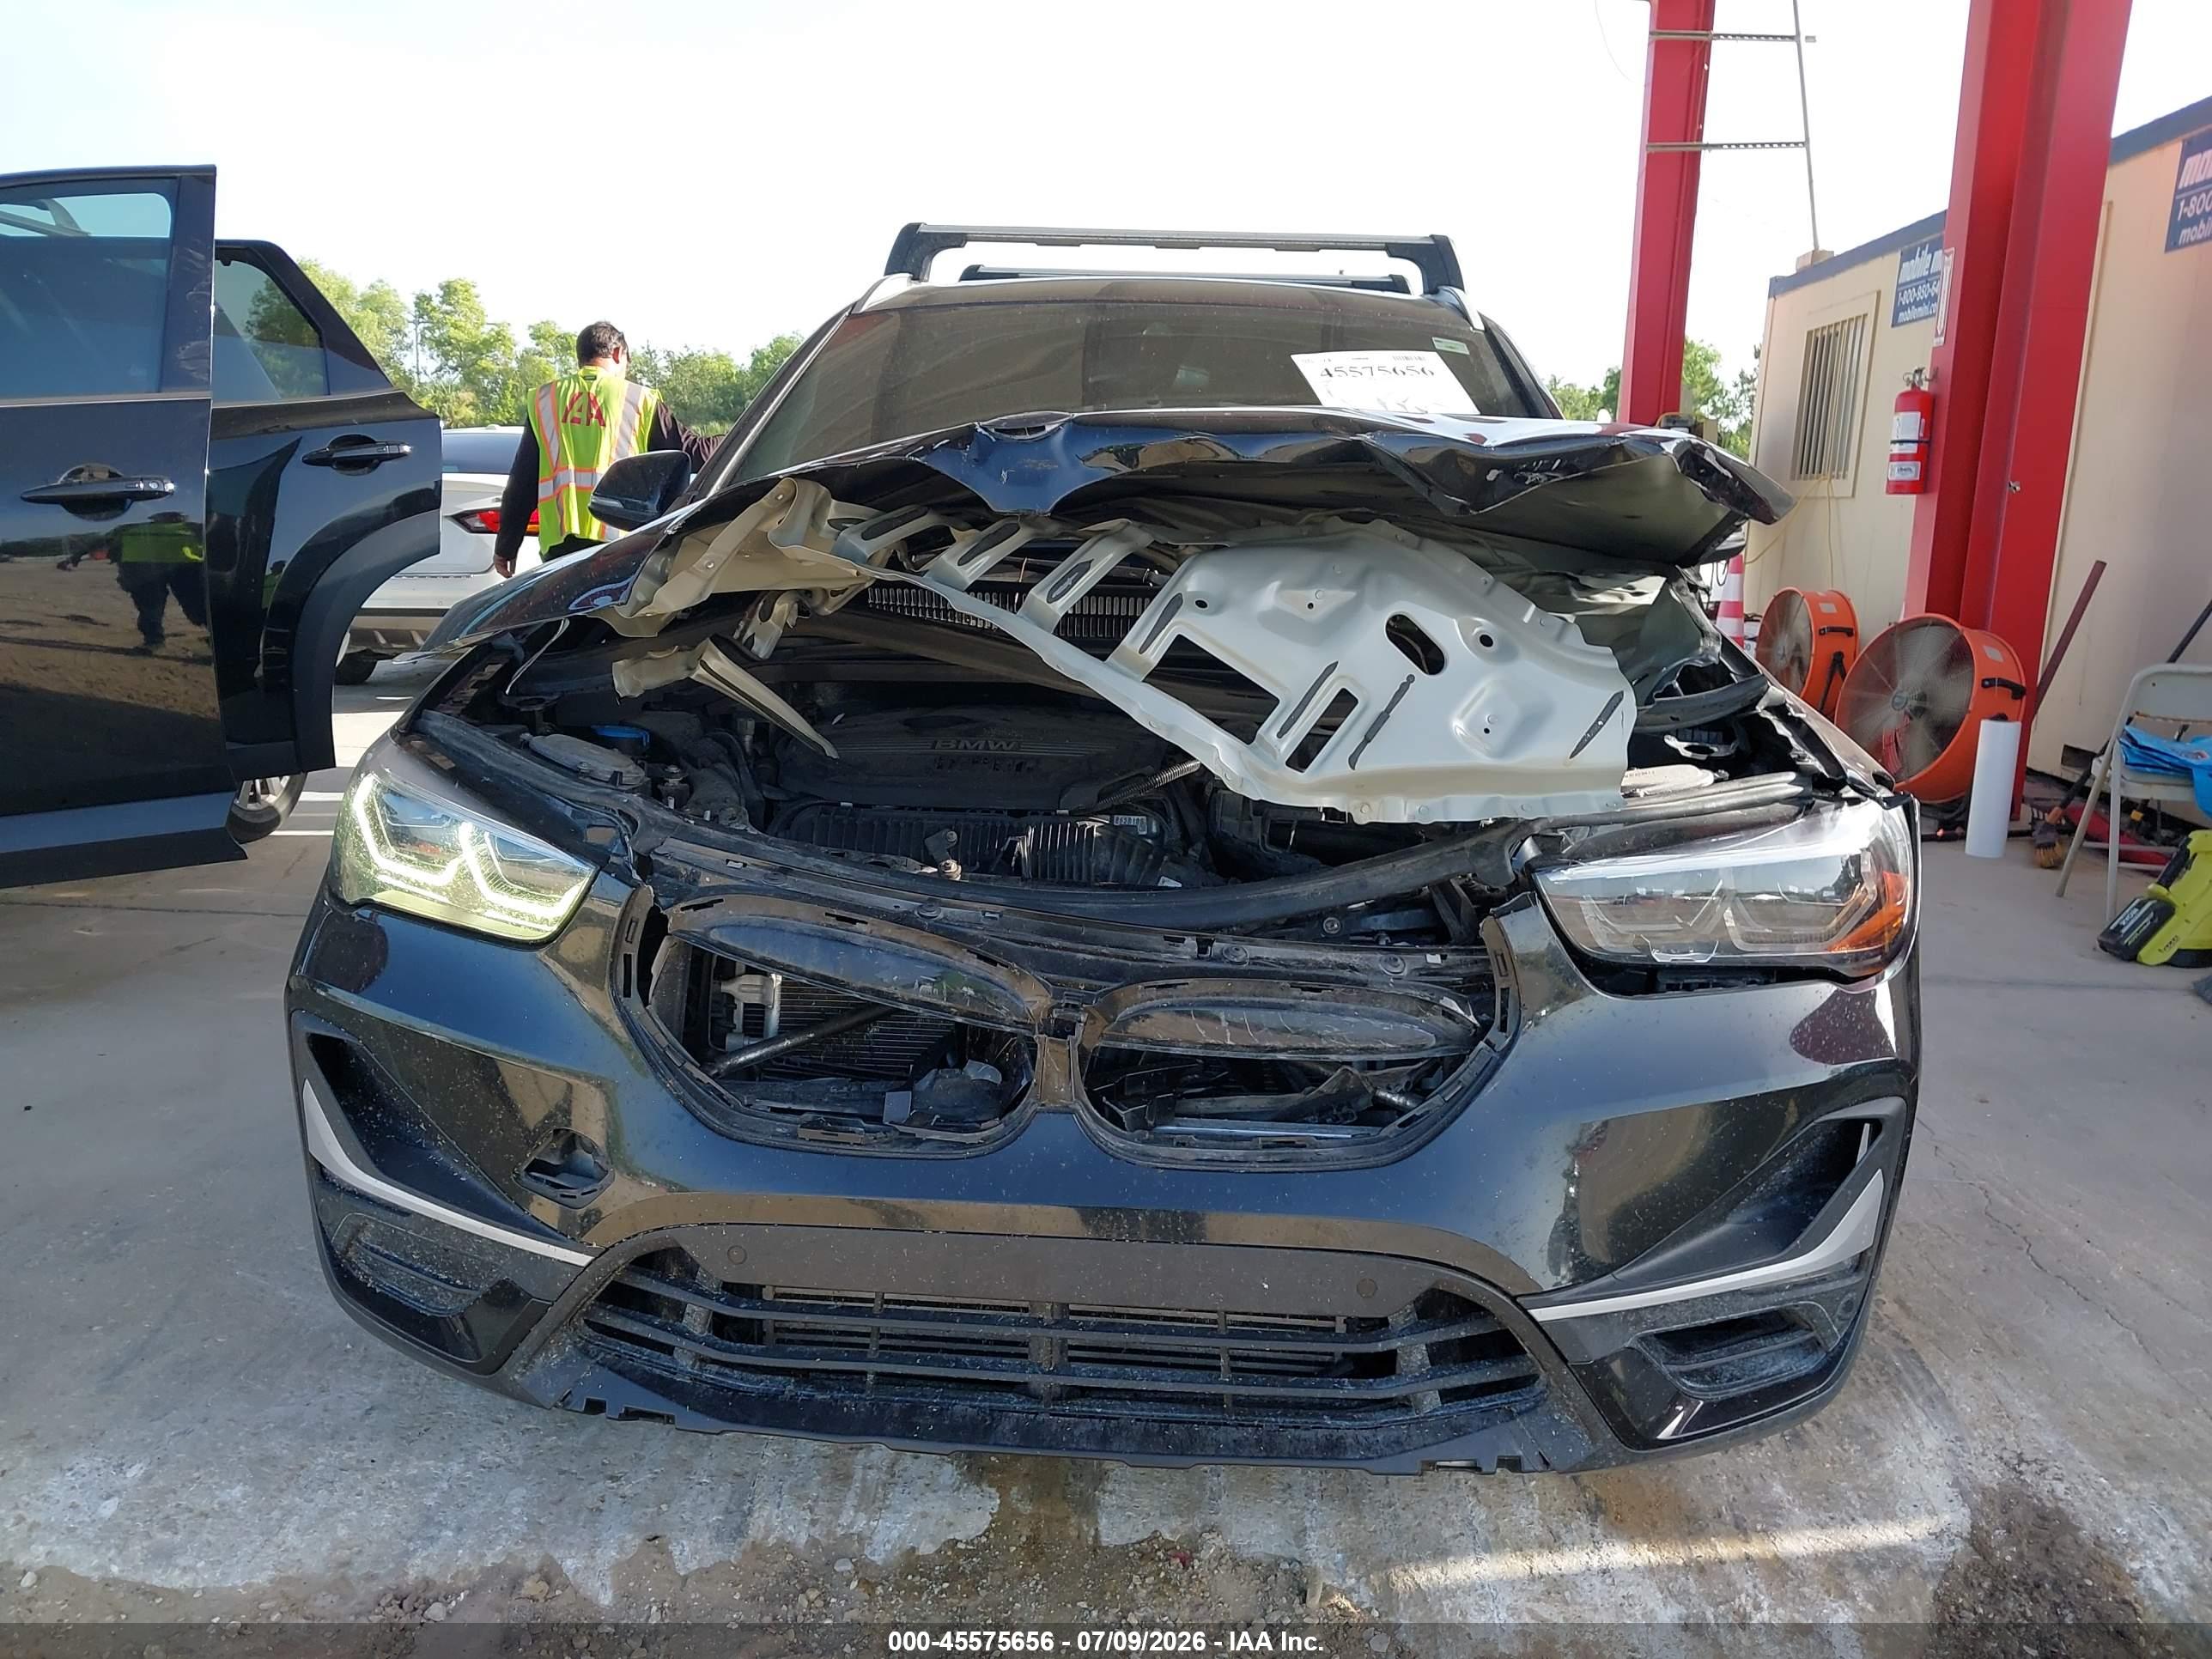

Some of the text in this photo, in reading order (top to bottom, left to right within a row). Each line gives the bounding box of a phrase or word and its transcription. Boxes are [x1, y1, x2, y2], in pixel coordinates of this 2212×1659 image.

[1899, 244, 1932, 284] mobile
[1321, 365, 1435, 379] 45575656
[935, 739, 1018, 750] BMW
